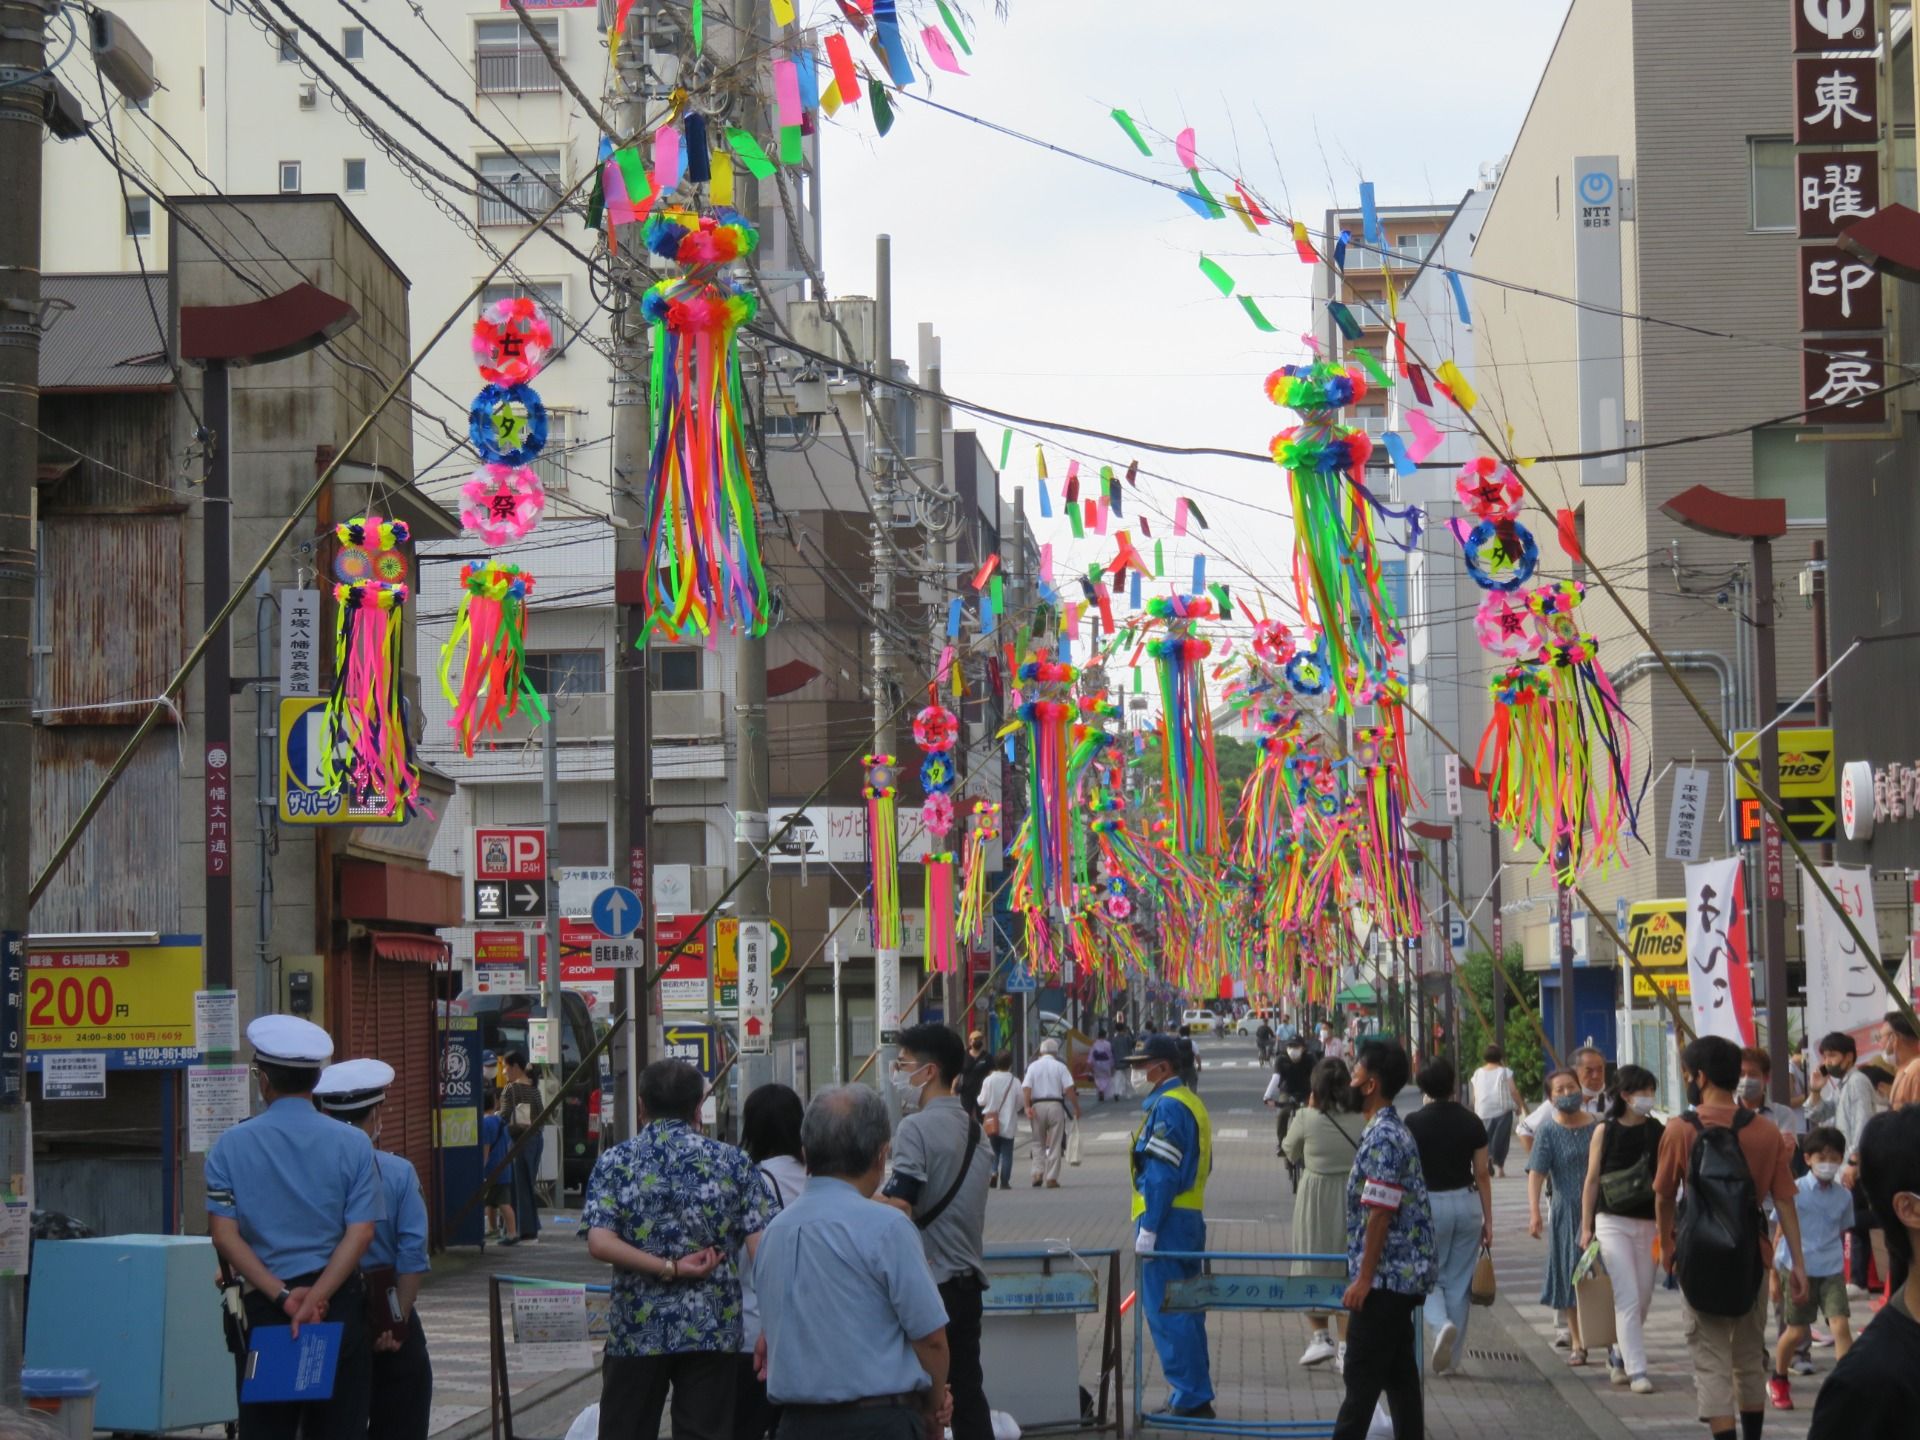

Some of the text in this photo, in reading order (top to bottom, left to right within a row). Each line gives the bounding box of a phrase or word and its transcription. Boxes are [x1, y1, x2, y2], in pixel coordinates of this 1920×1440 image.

[1583, 206, 1610, 217] NTT
[1584, 219, 1610, 227] 東日本
[1803, 70, 1880, 408] 東曜印房
[289, 607, 311, 693] 平塚八幡宮表参道
[1778, 764, 1822, 776] mes
[209, 772, 228, 870] 八幡大門通り
[1675, 784, 1700, 857] 平塚八幡宮表参道
[514, 836, 541, 873] P
[522, 862, 541, 873] 24H
[1766, 827, 1781, 896] 八幡大門通り
[478, 886, 500, 913] 空
[1452, 923, 1463, 942] P
[1632, 925, 1684, 958] Times
[29, 954, 54, 966] 庫後
[595, 945, 640, 962] 自転車を除く
[9, 941, 20, 1008] 明石町
[29, 976, 129, 1026] 200 円
[9, 1031, 18, 1049] 9
